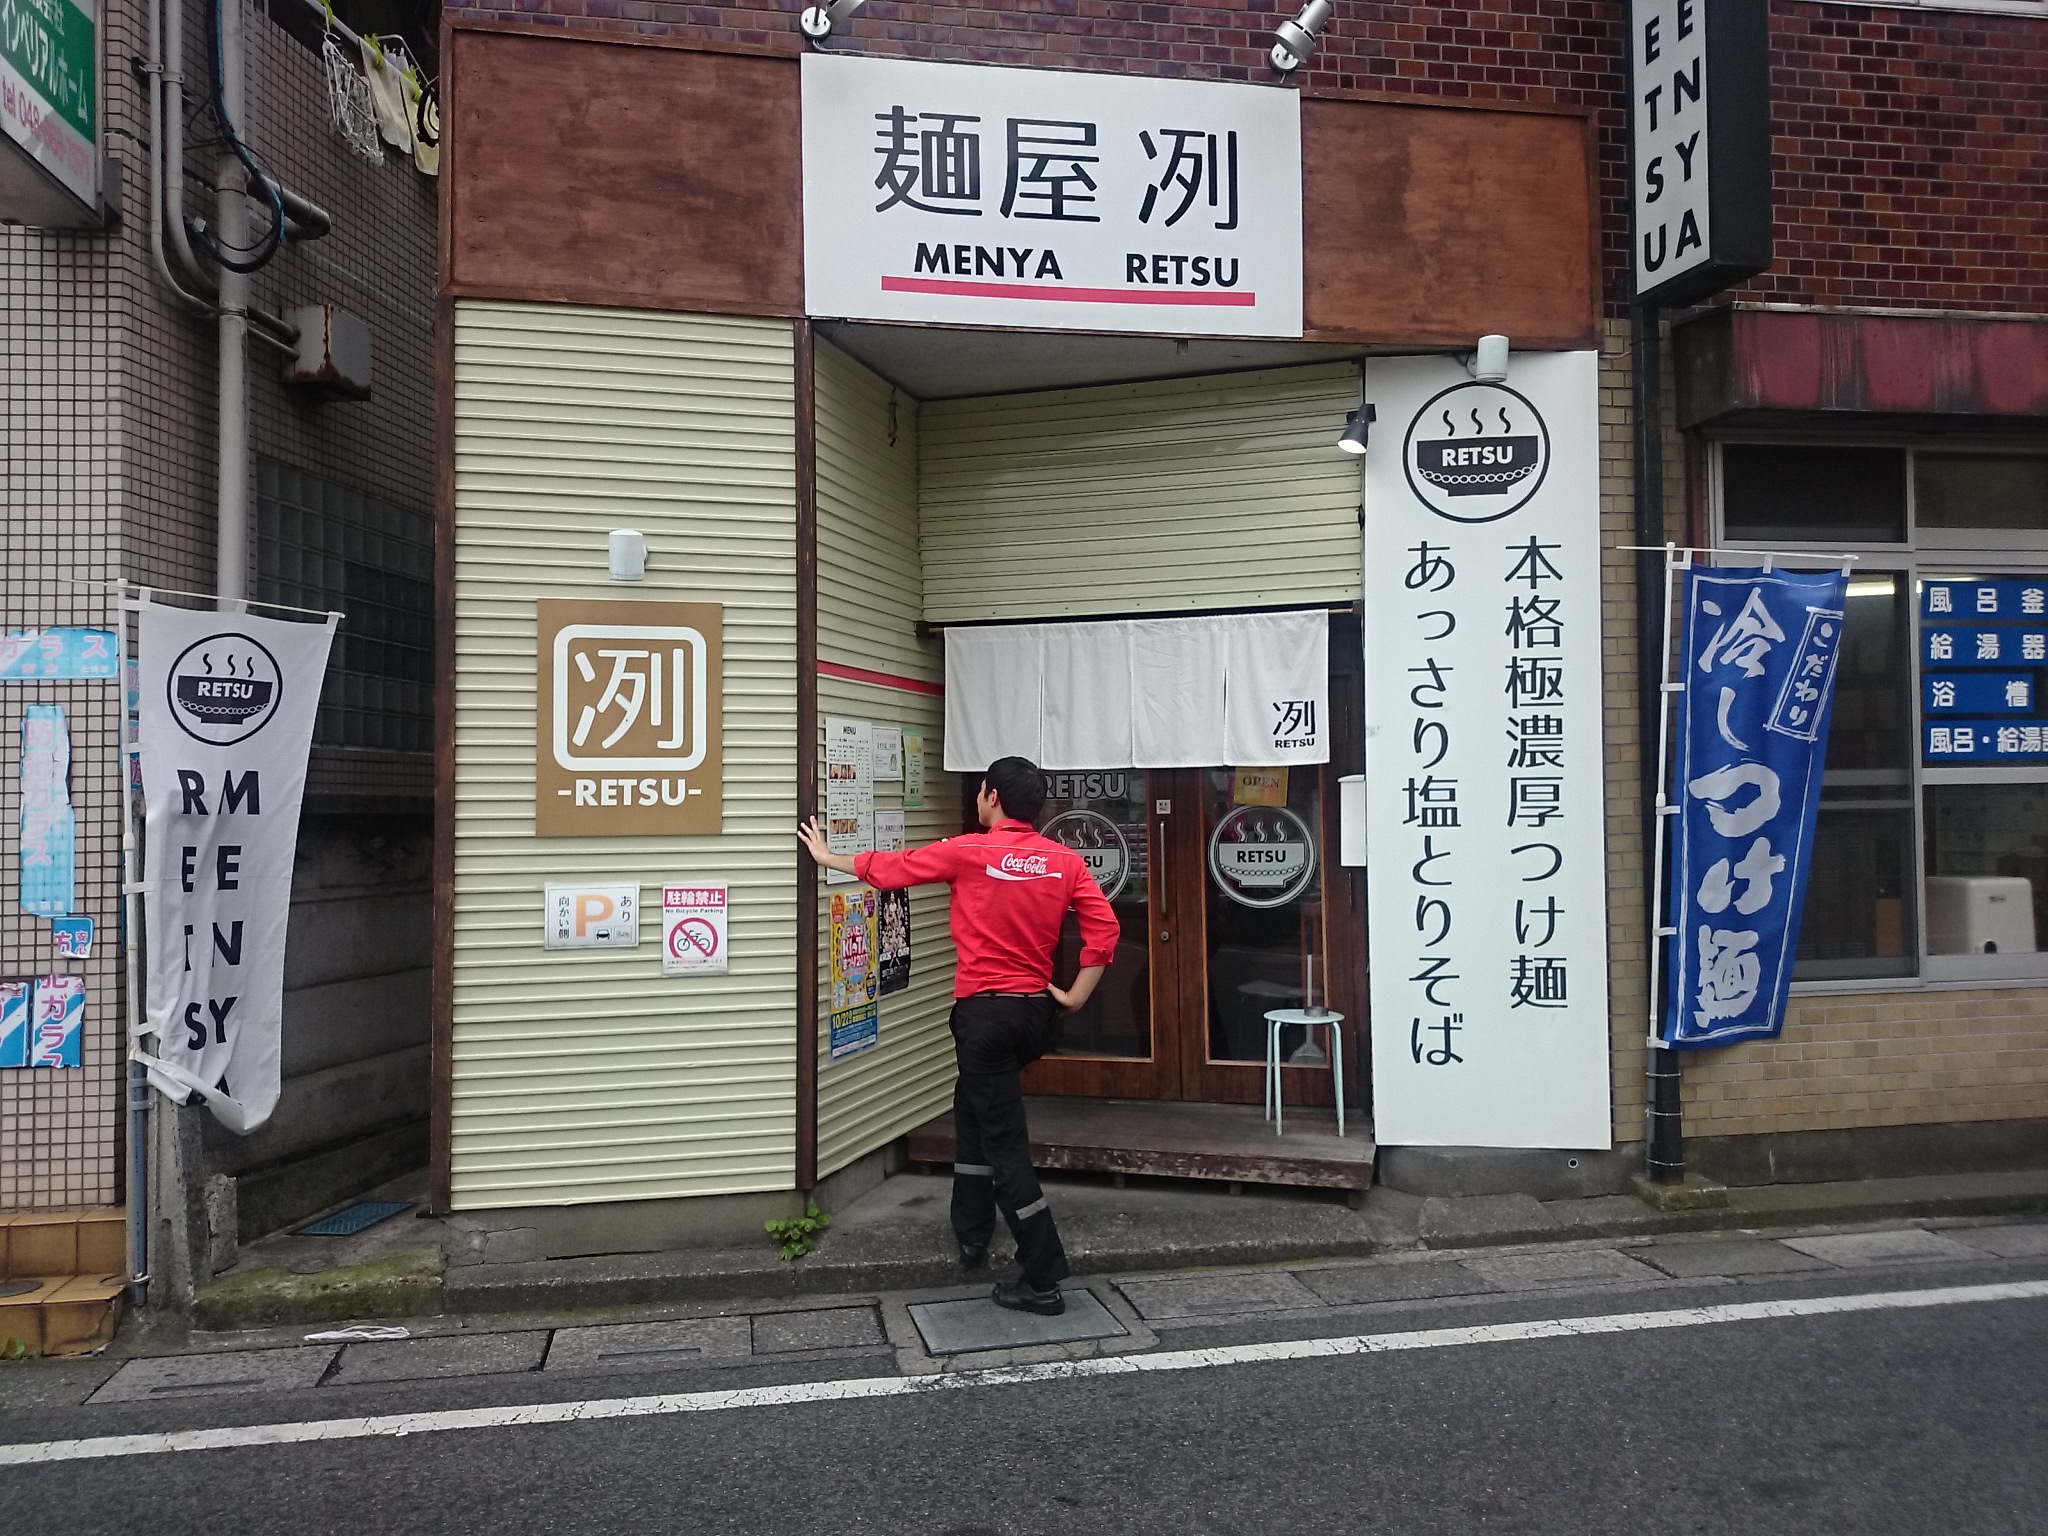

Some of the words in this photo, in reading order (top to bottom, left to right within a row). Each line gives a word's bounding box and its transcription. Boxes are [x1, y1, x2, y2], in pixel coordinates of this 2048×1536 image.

[873, 105, 1101, 224] 麺屋
[1138, 128, 1238, 231] 冽
[913, 242, 1064, 281] MENYA
[1125, 253, 1240, 287] RETSU
[1441, 445, 1514, 467] RETSU
[1928, 586, 2046, 614] 風呂釜
[1929, 632, 2046, 660] 給湯器
[197, 681, 254, 700] RETSU
[1789, 621, 1835, 728] こだわり
[571, 647, 685, 751] 冽
[1931, 680, 2030, 708] 浴槽
[842, 725, 857, 735] MENU
[1272, 700, 1316, 736] 冽
[1274, 738, 1316, 749] RETSU
[1242, 775, 1281, 789] OPEN
[1504, 535, 1569, 1009] 本格極濃厚つけ麺
[1402, 540, 1463, 1066] あっさり塩とりそば
[1687, 586, 1787, 1029] 冷しつけ麺
[1236, 850, 1287, 864] RETSU
[620, 896, 632, 923] あり
[666, 890, 724, 906] 駐輪禁止
[558, 896, 570, 939] 向かい側
[575, 894, 615, 938] P
[209, 769, 261, 1098] MENY
